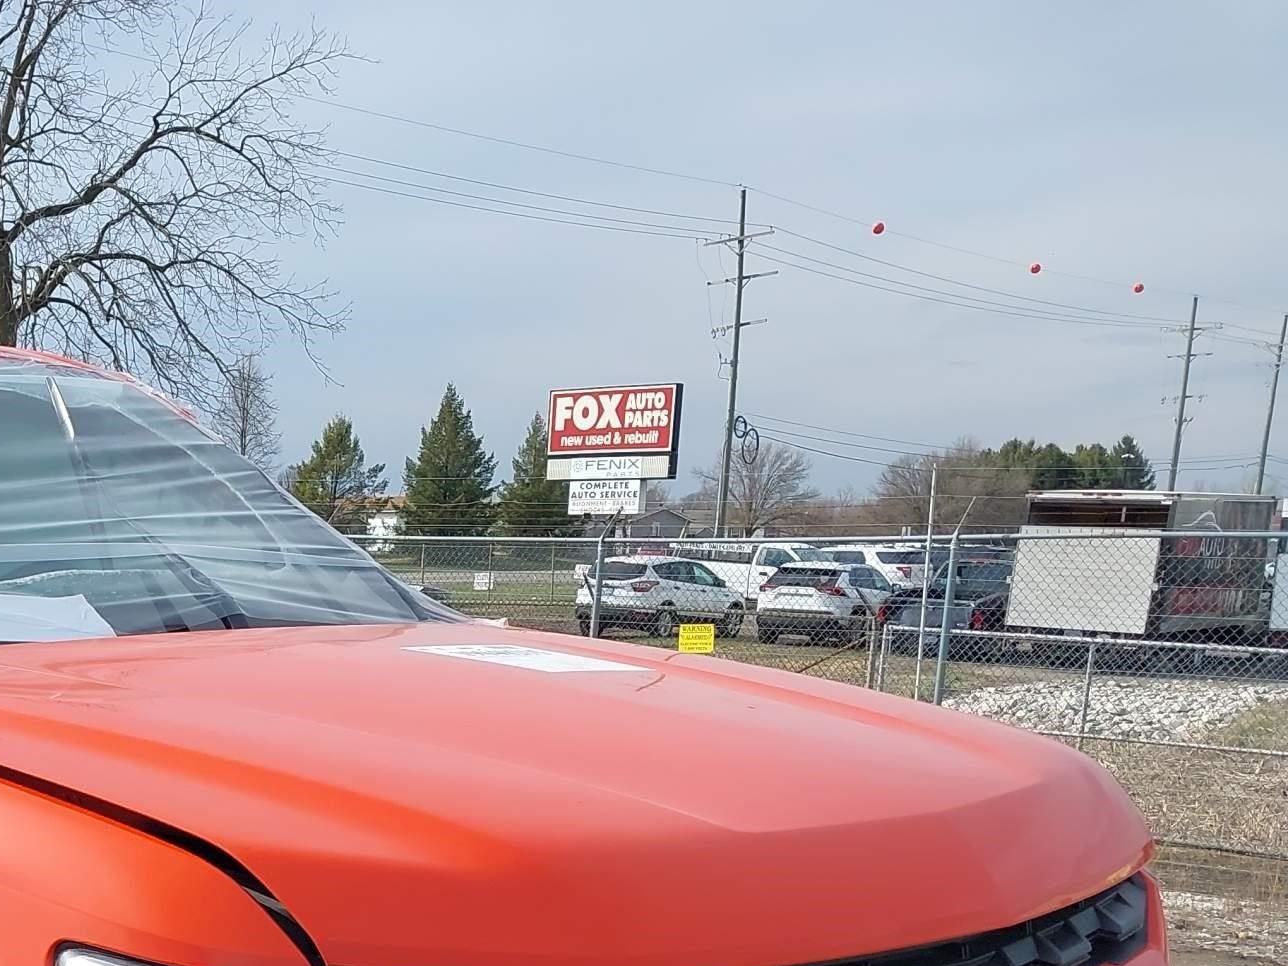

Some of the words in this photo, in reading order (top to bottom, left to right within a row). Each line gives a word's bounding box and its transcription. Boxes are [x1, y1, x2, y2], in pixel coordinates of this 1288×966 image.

[554, 394, 624, 431] FOX
[625, 391, 666, 410] AUTO
[624, 409, 669, 428] PARTS
[560, 435, 582, 447] new
[585, 432, 611, 445] used
[613, 431, 621, 444] &
[624, 430, 659, 444] rebuilt
[585, 458, 640, 471] FENIX
[579, 482, 630, 490] COMPLETE
[571, 491, 597, 499] AUTO
[599, 490, 638, 499] SERVICE
[682, 625, 712, 633] WARNING
